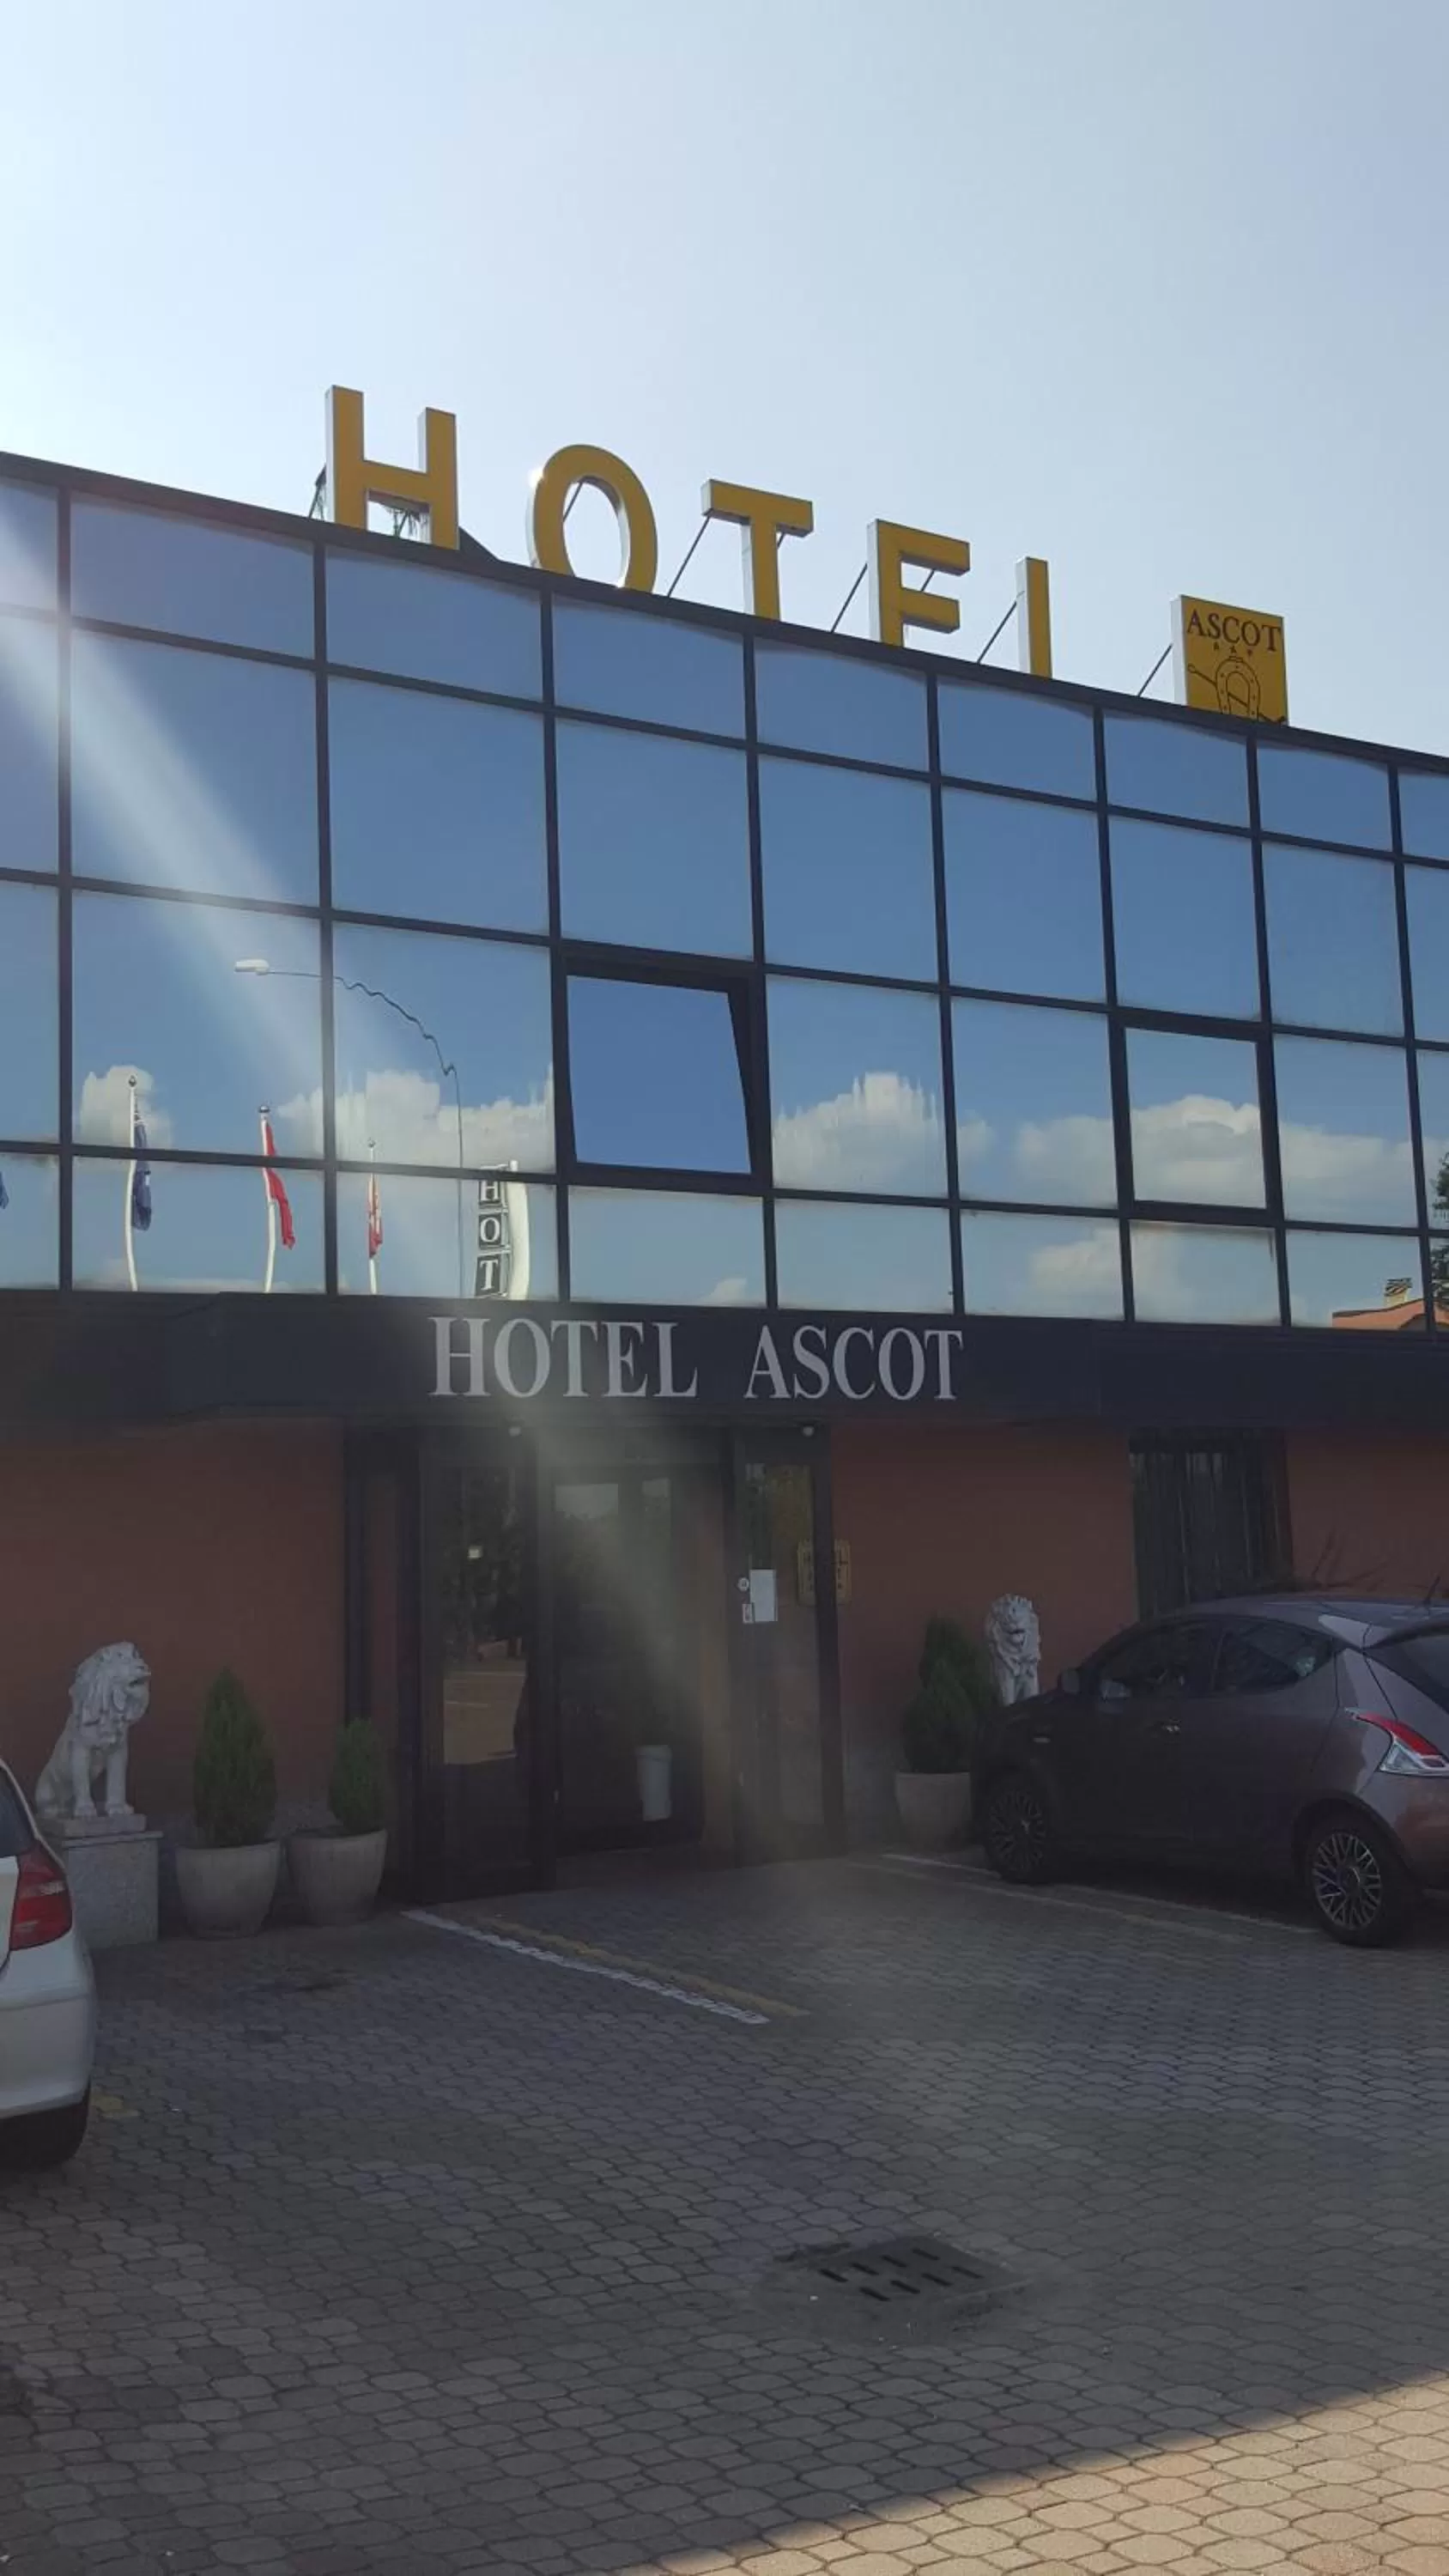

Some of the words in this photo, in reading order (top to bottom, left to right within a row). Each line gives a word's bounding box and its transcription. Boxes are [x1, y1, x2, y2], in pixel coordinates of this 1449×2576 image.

[1186, 608, 1282, 653] ASCOT
[428, 1316, 697, 1398] HOTEL
[743, 1325, 962, 1401] ASCOT
